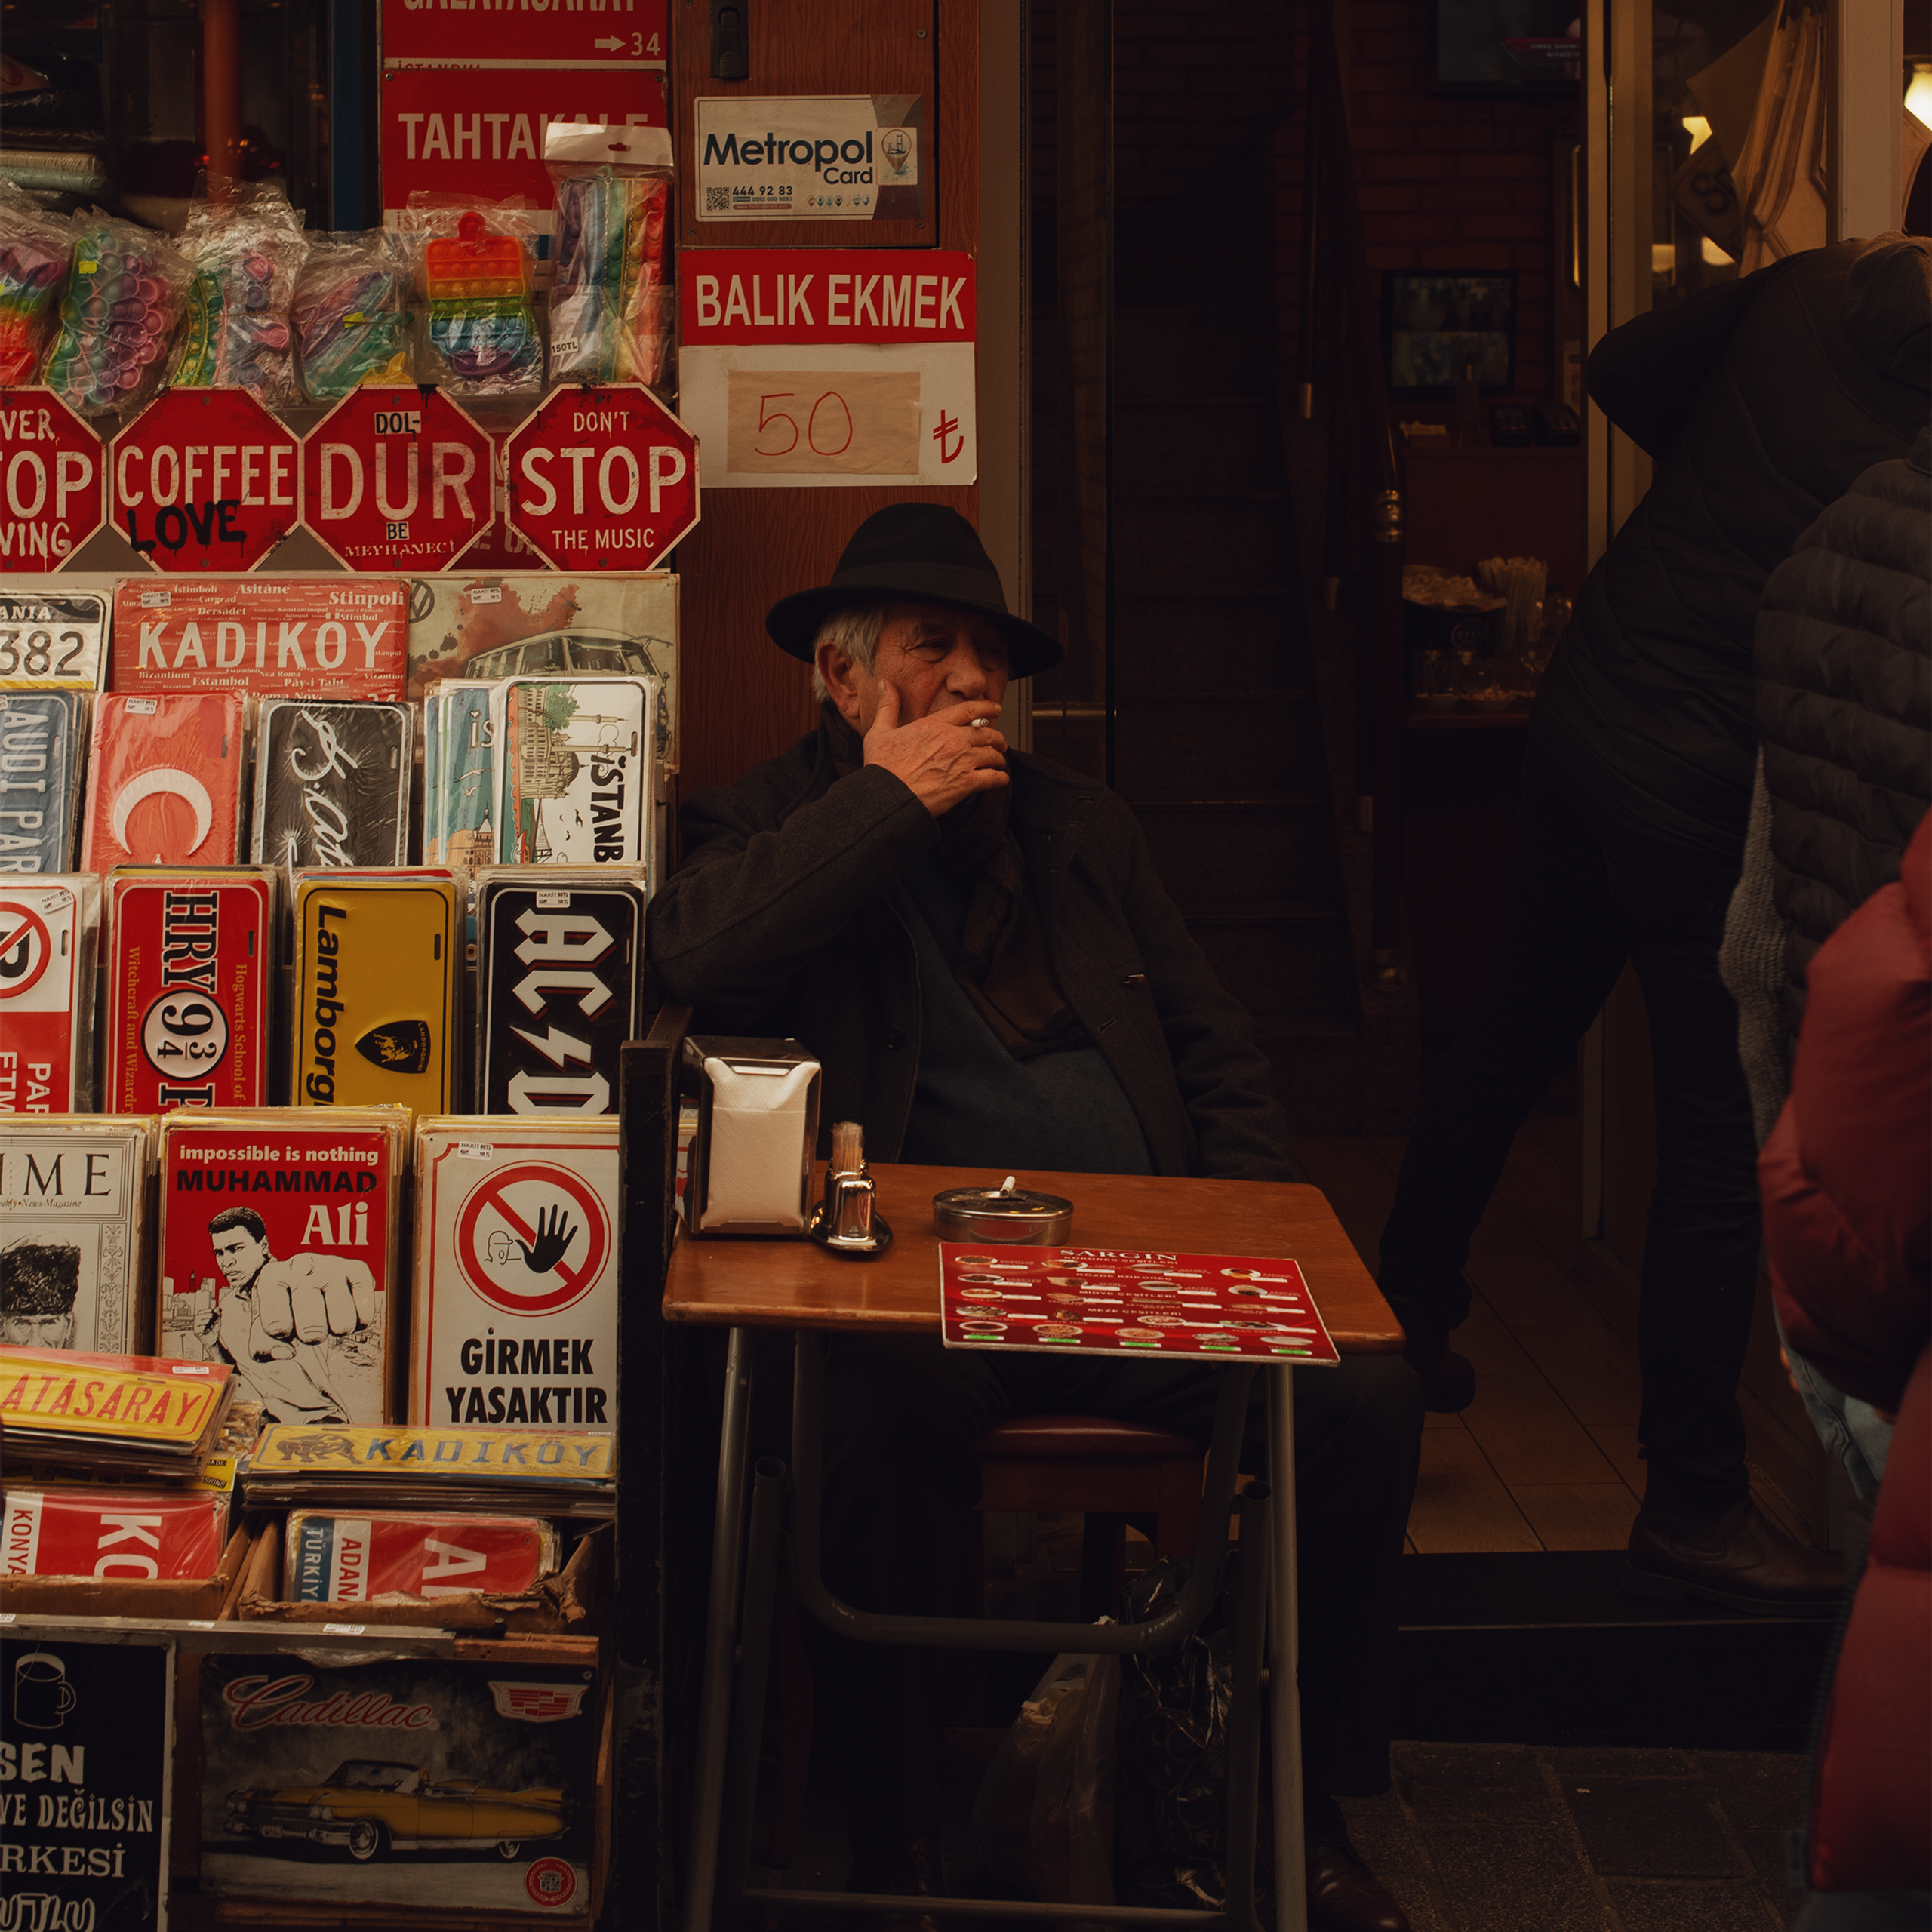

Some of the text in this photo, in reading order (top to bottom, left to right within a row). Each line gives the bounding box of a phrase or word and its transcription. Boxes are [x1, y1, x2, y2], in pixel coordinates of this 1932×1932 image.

[631, 32, 660, 56] 34
[398, 113, 648, 160] TAHTA
[703, 131, 873, 172] Metropol
[733, 186, 793, 196] 444 92 83
[823, 167, 873, 185] Card
[696, 274, 968, 330] BALIK EKMEK
[552, 340, 578, 353] 150TL
[573, 411, 630, 433] DON'T
[755, 391, 853, 456] 50
[0, 450, 94, 519] OP
[117, 445, 294, 507] COFFEE
[320, 441, 477, 521] DUR
[521, 445, 687, 516] STOP
[126, 500, 248, 553] LOVE
[387, 523, 408, 540] BE
[552, 528, 654, 550] THE MUSIC
[329, 591, 404, 608] Stinpoli
[0, 630, 84, 676] 382
[0, 712, 49, 792] AUDI
[161, 891, 220, 995] HRY
[126, 946, 141, 1020] Witchcraft
[306, 905, 346, 1106] Lamborg
[126, 1023, 138, 1050] and
[232, 964, 248, 1102] Hogwarts School of
[417, 1022, 427, 1072] LAMBORGHINI
[180, 1145, 379, 1166] impossible is nothing
[176, 1170, 377, 1193] MUHAMMAD
[300, 1201, 370, 1246] Ali
[1060, 1249, 1177, 1260] SARGIN
[0, 1373, 202, 1426] ATASARAY
[445, 1387, 608, 1423] YASAKTIR
[203, 1476, 226, 1489] SIGNS
[302, 1528, 324, 1601] TÜRKİY
[337, 1537, 363, 1601] ADAN
[222, 1674, 434, 1731] Cadillac
[0, 1742, 85, 1785] SEN
[37, 1789, 153, 1832] DEĞİLSİN
